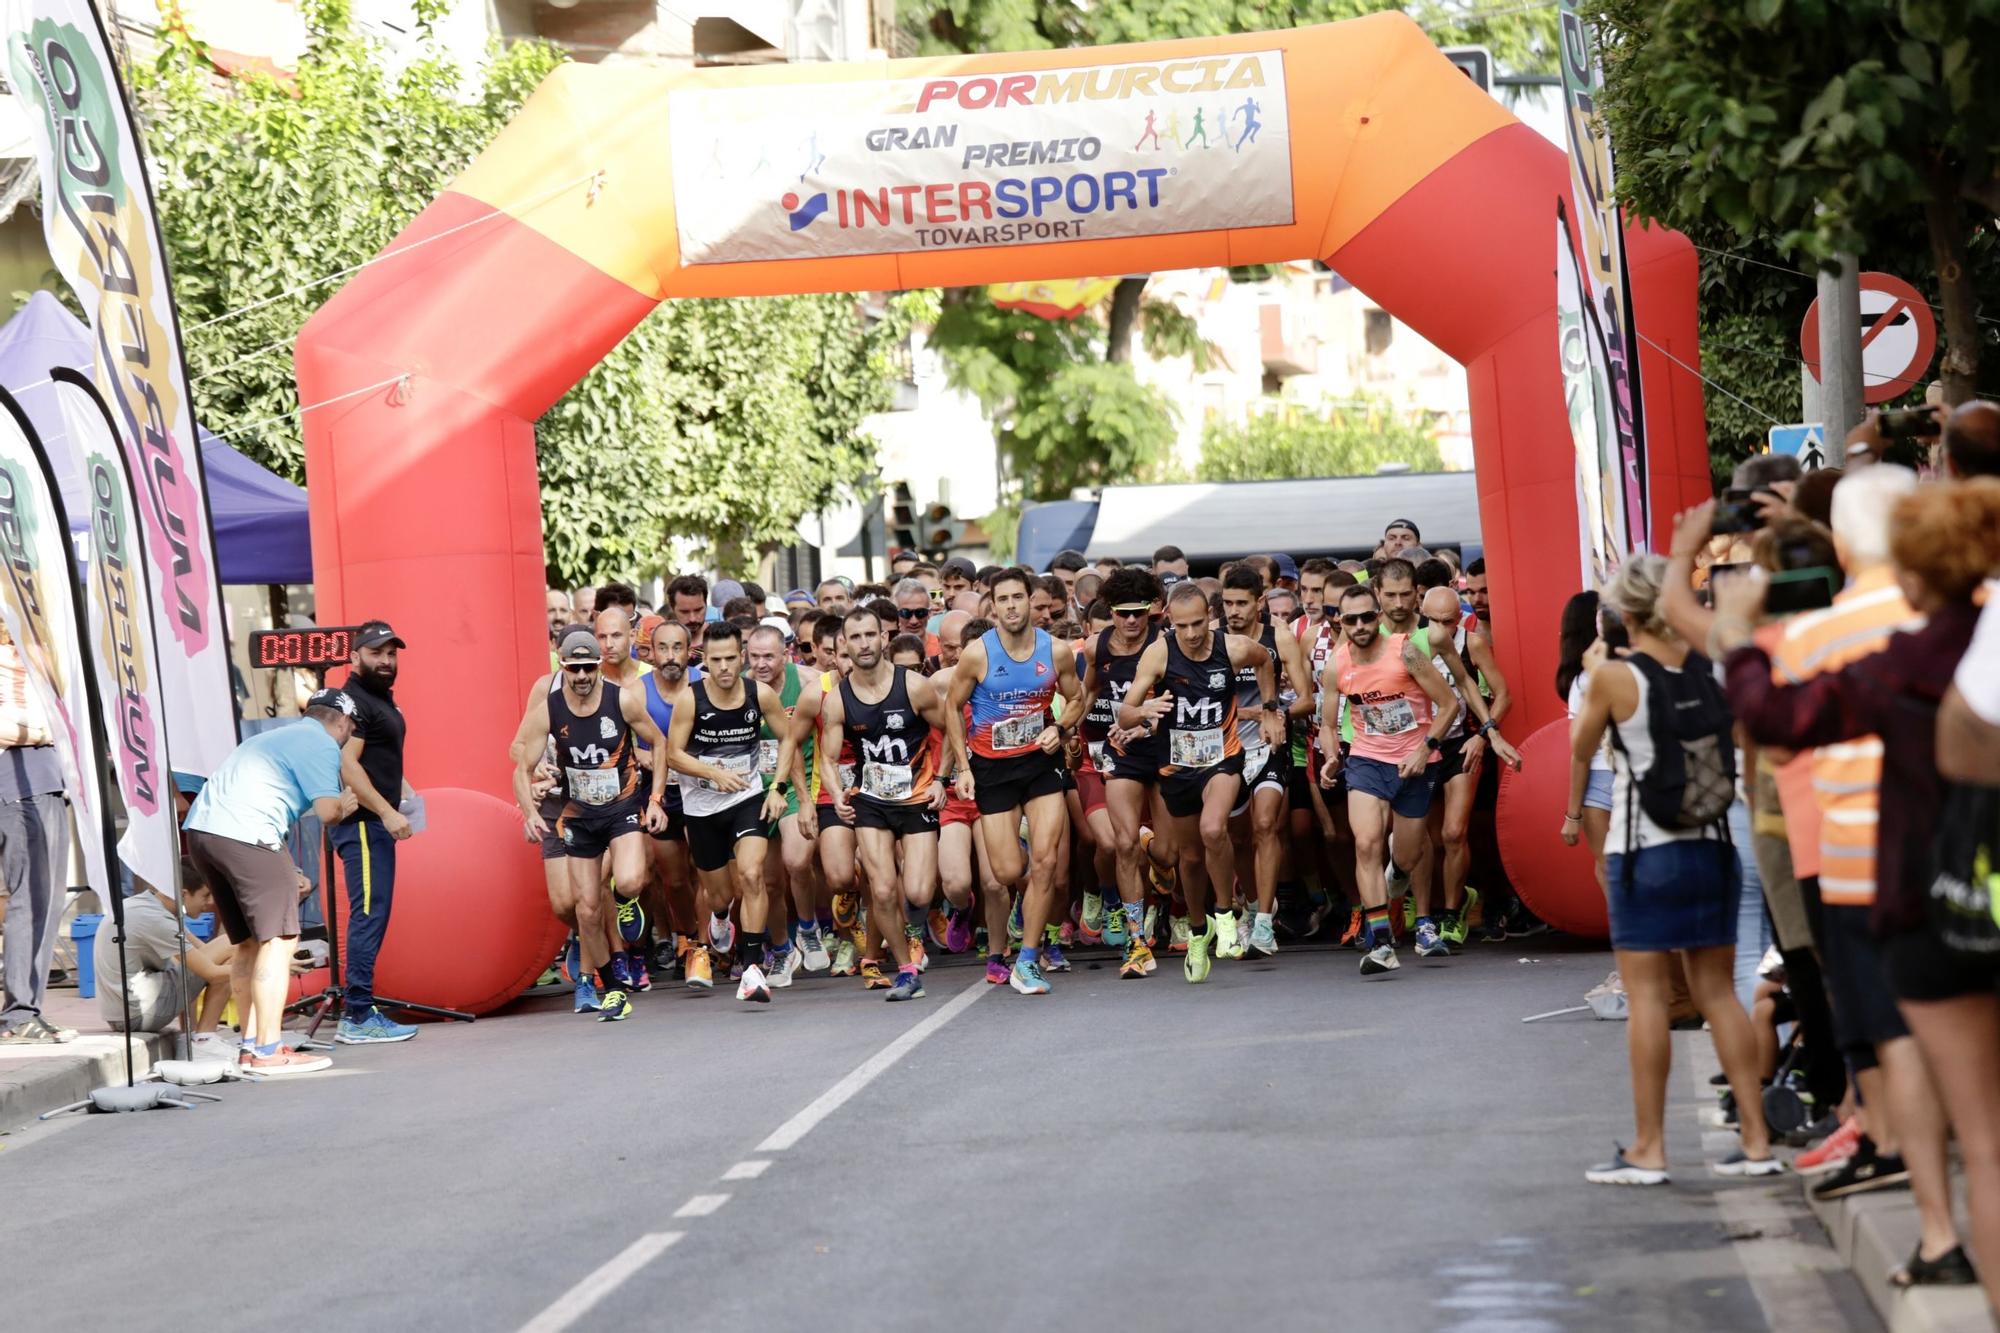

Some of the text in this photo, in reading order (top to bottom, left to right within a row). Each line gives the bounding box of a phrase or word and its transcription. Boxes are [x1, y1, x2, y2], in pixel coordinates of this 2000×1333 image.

[914, 56, 1266, 113] PORMURCIA
[866, 124, 958, 152] GRAN
[962, 136, 1101, 169] PREMIO
[837, 168, 1167, 229] INTERSPORT
[916, 219, 1085, 246] TOVARSPORT
